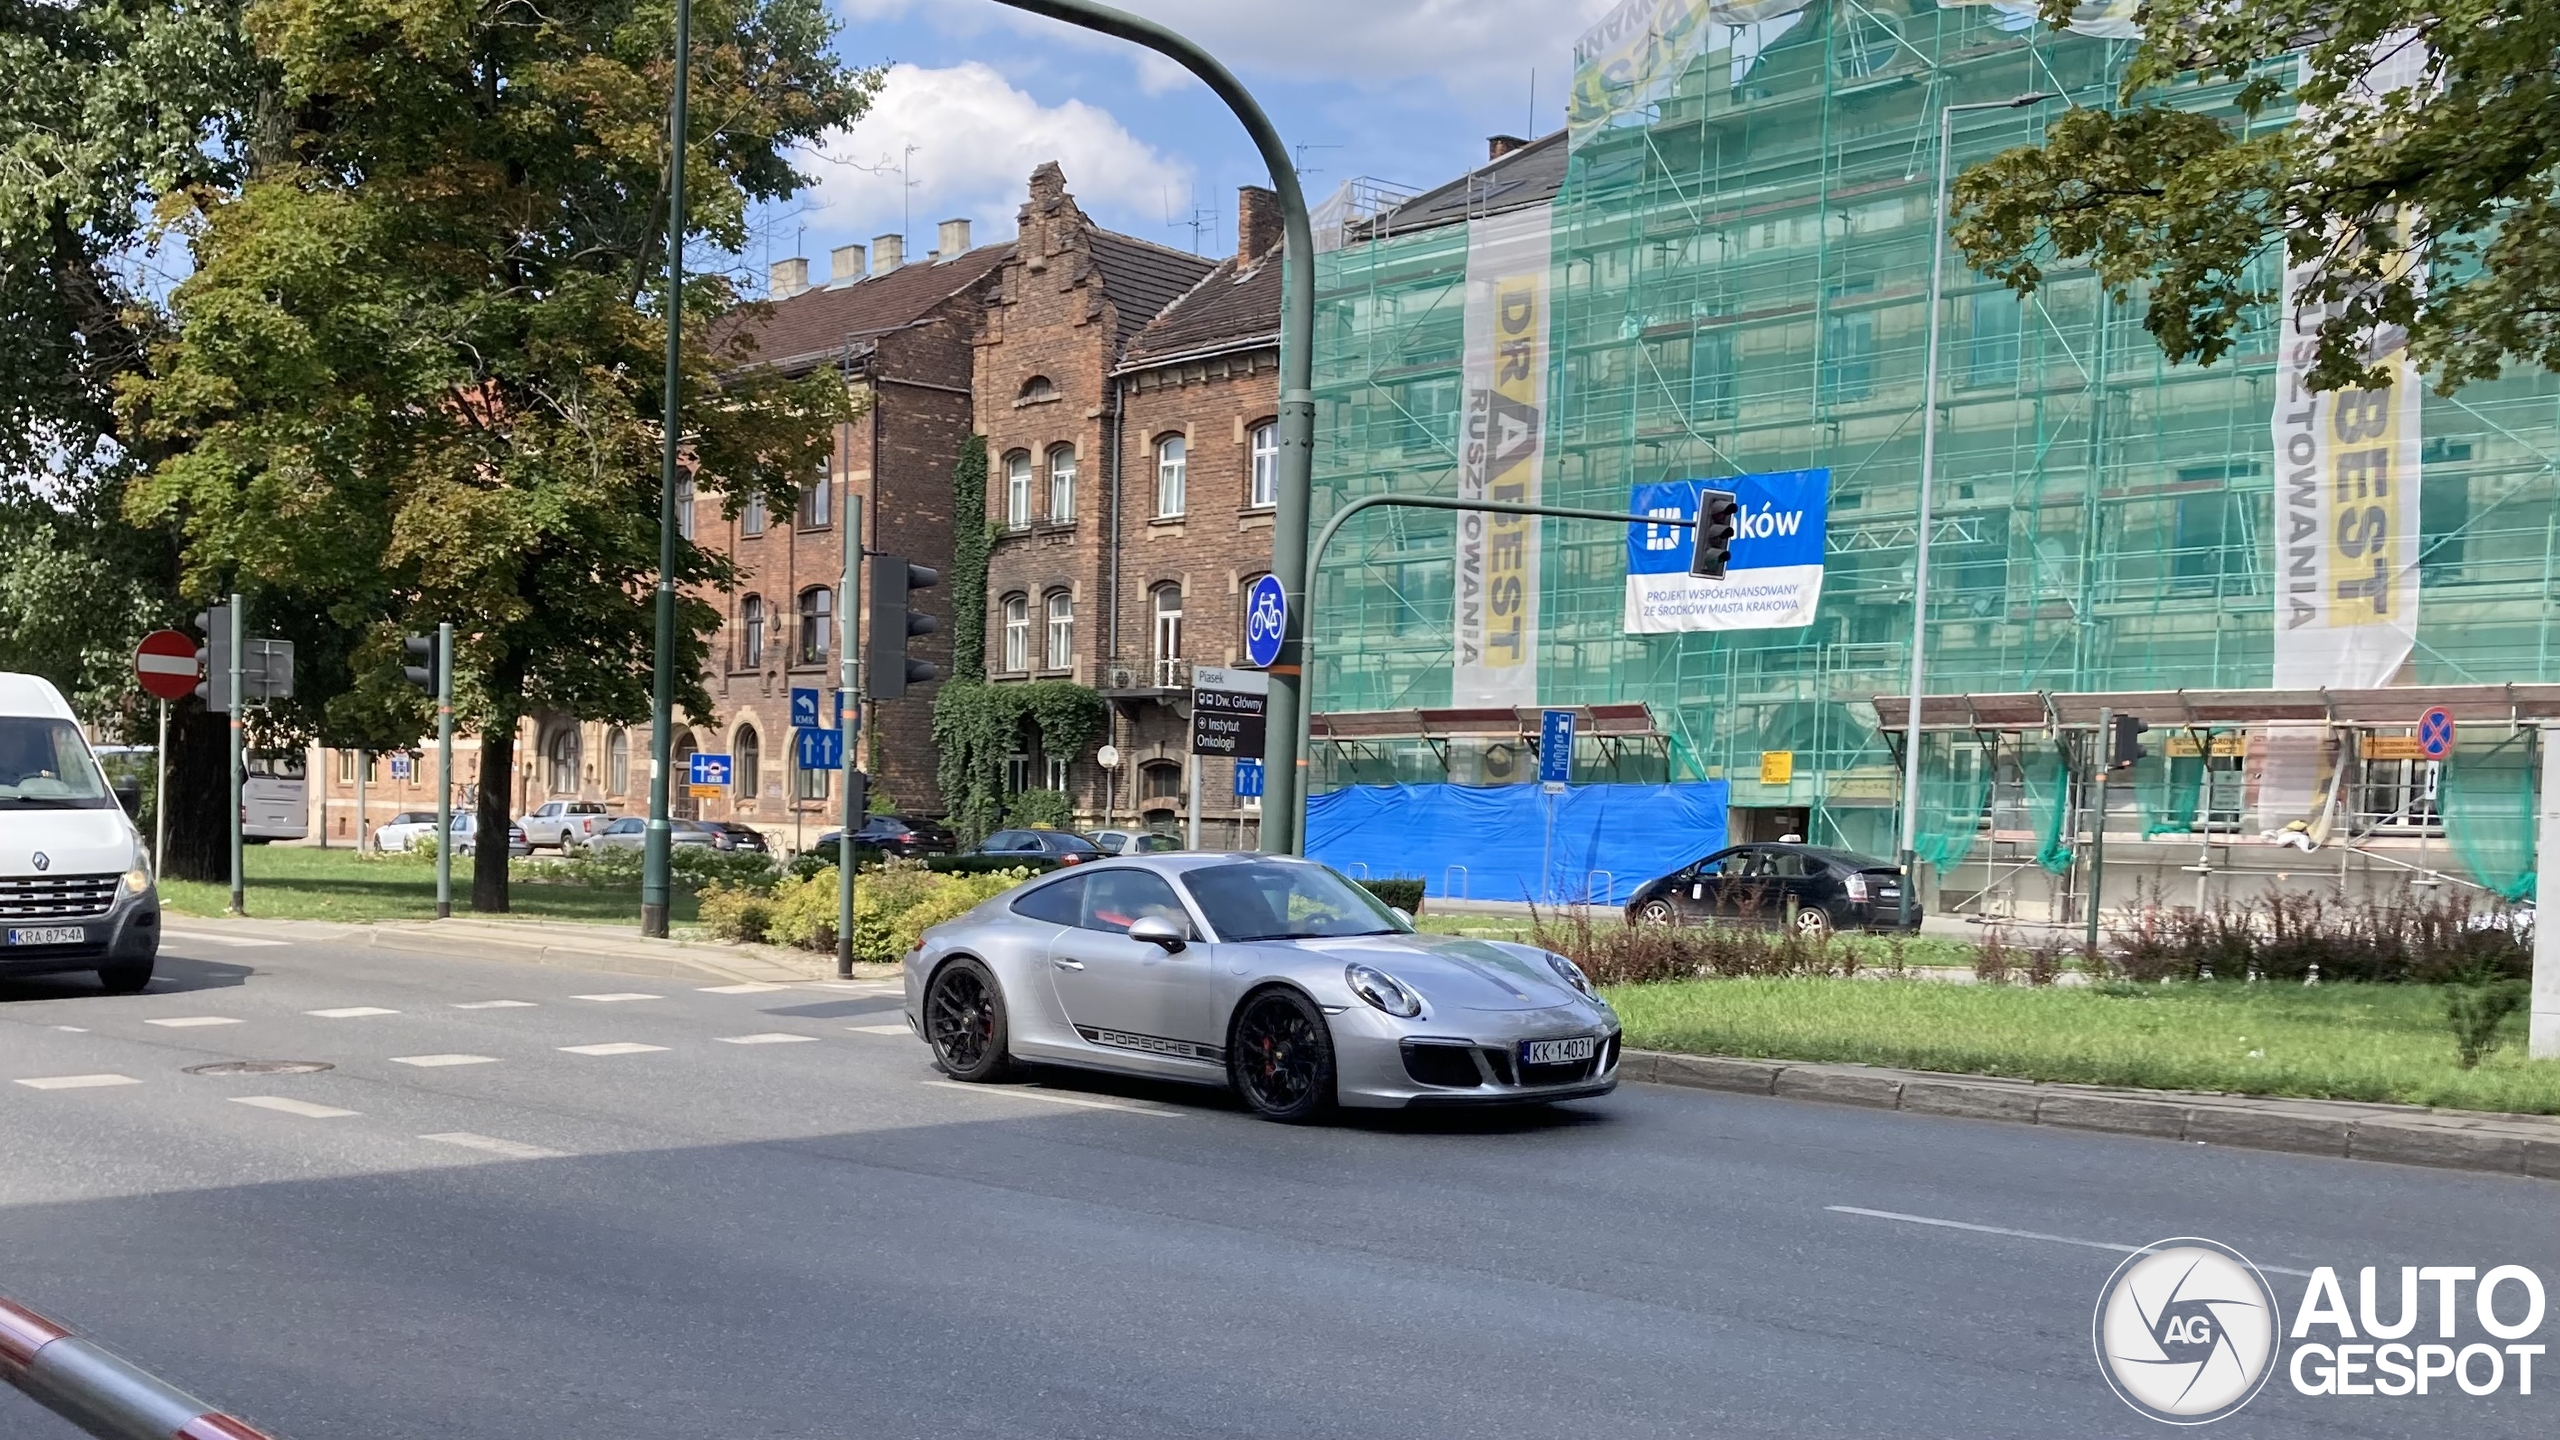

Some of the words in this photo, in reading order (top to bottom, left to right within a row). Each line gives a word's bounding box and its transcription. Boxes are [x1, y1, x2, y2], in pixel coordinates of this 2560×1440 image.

[1691, 501, 1803, 542] ków
[1647, 590, 1687, 602] PROJEKT
[1688, 585, 1798, 600] WSPÓŁFINANSOWANY
[1643, 606, 1655, 616] ZE
[1657, 603, 1707, 616] ŚRODKÓW
[1708, 602, 1744, 614] MIASTA
[1745, 600, 1799, 612] KRAKOWA
[1199, 671, 1224, 684] Piasek
[1216, 694, 1231, 708] Dw.
[1232, 695, 1263, 713] Główny
[795, 715, 815, 724] KMK
[1208, 718, 1240, 734] Instytut
[1197, 734, 1236, 752] Onkologii
[18, 930, 41, 942] KRA
[46, 928, 82, 942] 8754A
[1103, 1032, 1192, 1055] PORSCHE
[1533, 1042, 1550, 1061] KK
[1557, 1038, 1591, 1060] 14031
